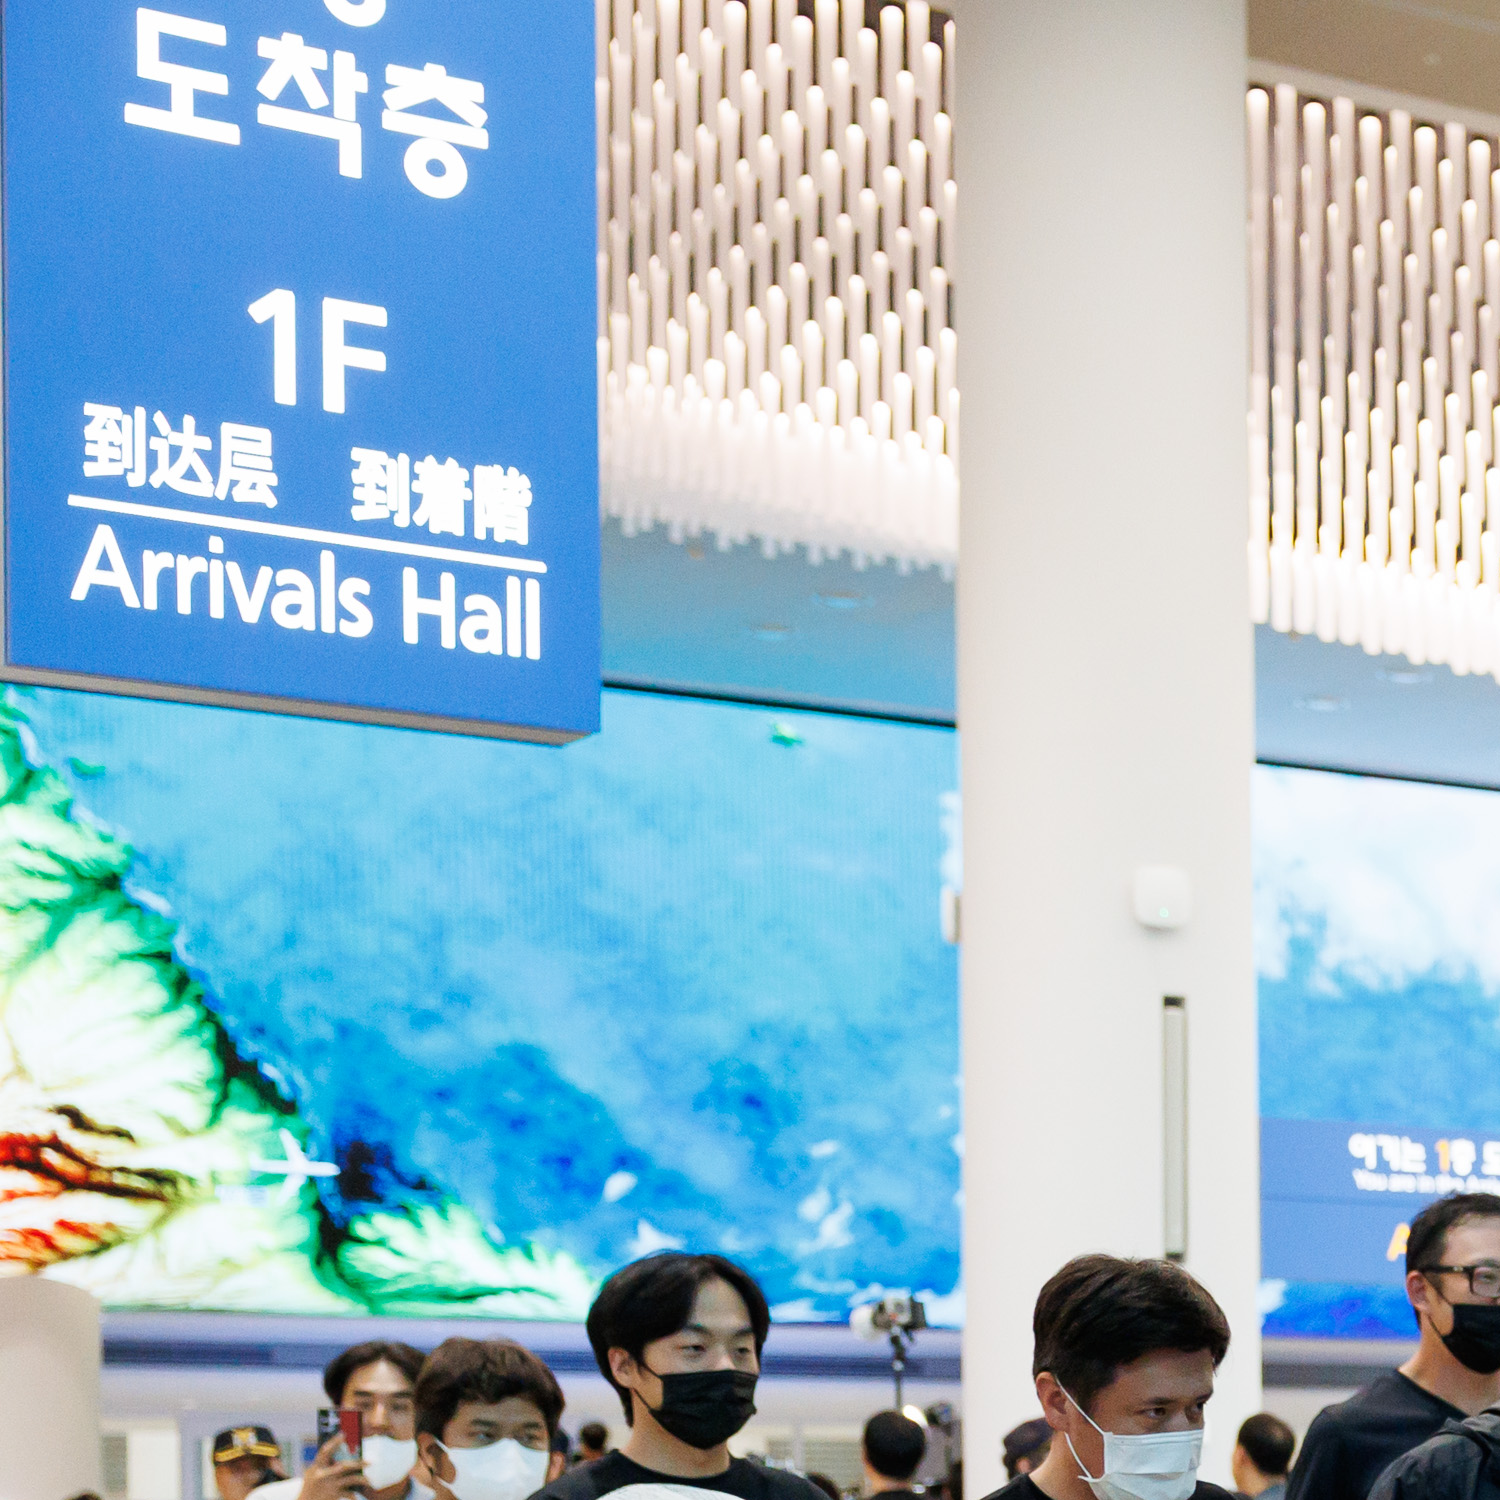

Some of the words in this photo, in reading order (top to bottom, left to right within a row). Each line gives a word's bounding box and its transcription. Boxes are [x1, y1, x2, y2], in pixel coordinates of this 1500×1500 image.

[124, 8, 489, 199] 도착층
[248, 289, 387, 414] 1F
[83, 402, 278, 508] 到达层
[351, 447, 532, 545] 到着階
[70, 523, 374, 638] Arrivals
[403, 567, 541, 659] Hall
